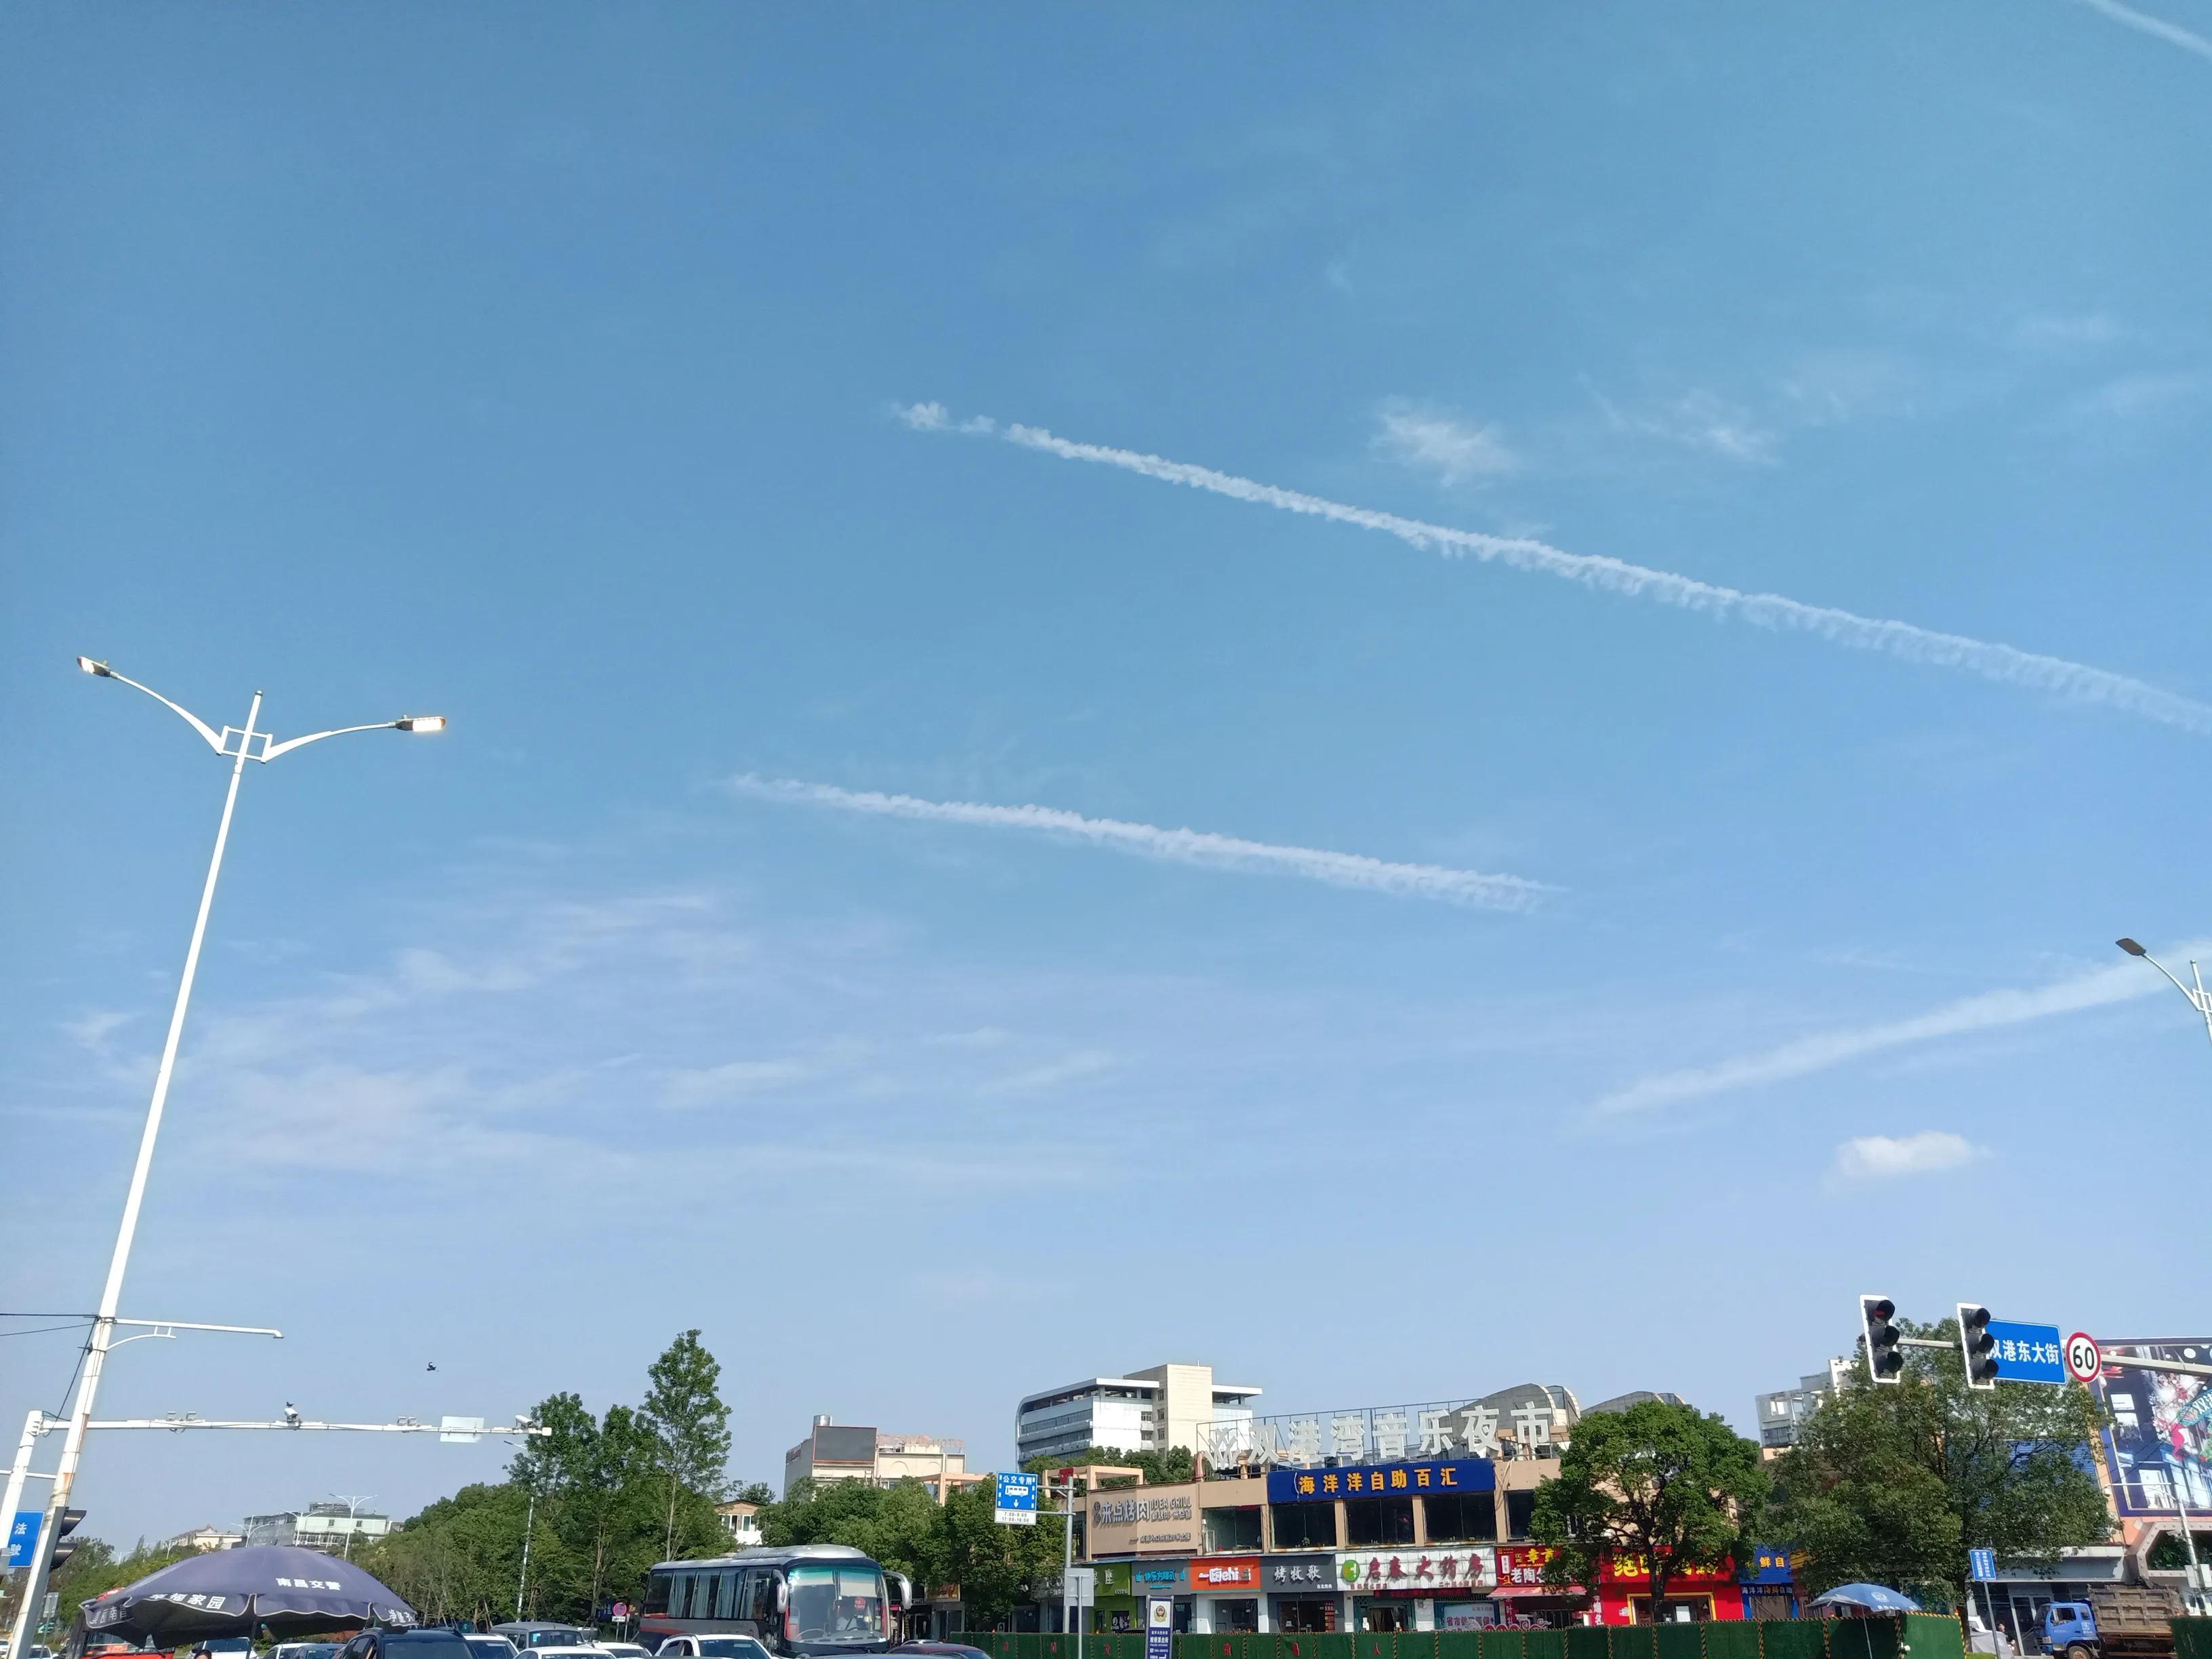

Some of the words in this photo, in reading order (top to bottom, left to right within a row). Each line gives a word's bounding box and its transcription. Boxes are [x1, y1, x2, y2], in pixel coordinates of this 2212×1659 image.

[2072, 1345, 2094, 1370] 60
[1003, 1475, 1032, 1485] 公交专用
[1298, 1467, 1457, 1495] 海洋洋自助百汇
[1152, 1498, 1168, 1510] IDEA
[1170, 1496, 1191, 1509] GRILL
[1101, 1500, 1149, 1524] 来点烤肉
[14, 1523, 27, 1535] 法
[275, 1578, 342, 1591] 南昌交警
[148, 1593, 226, 1610] 幸福家园
